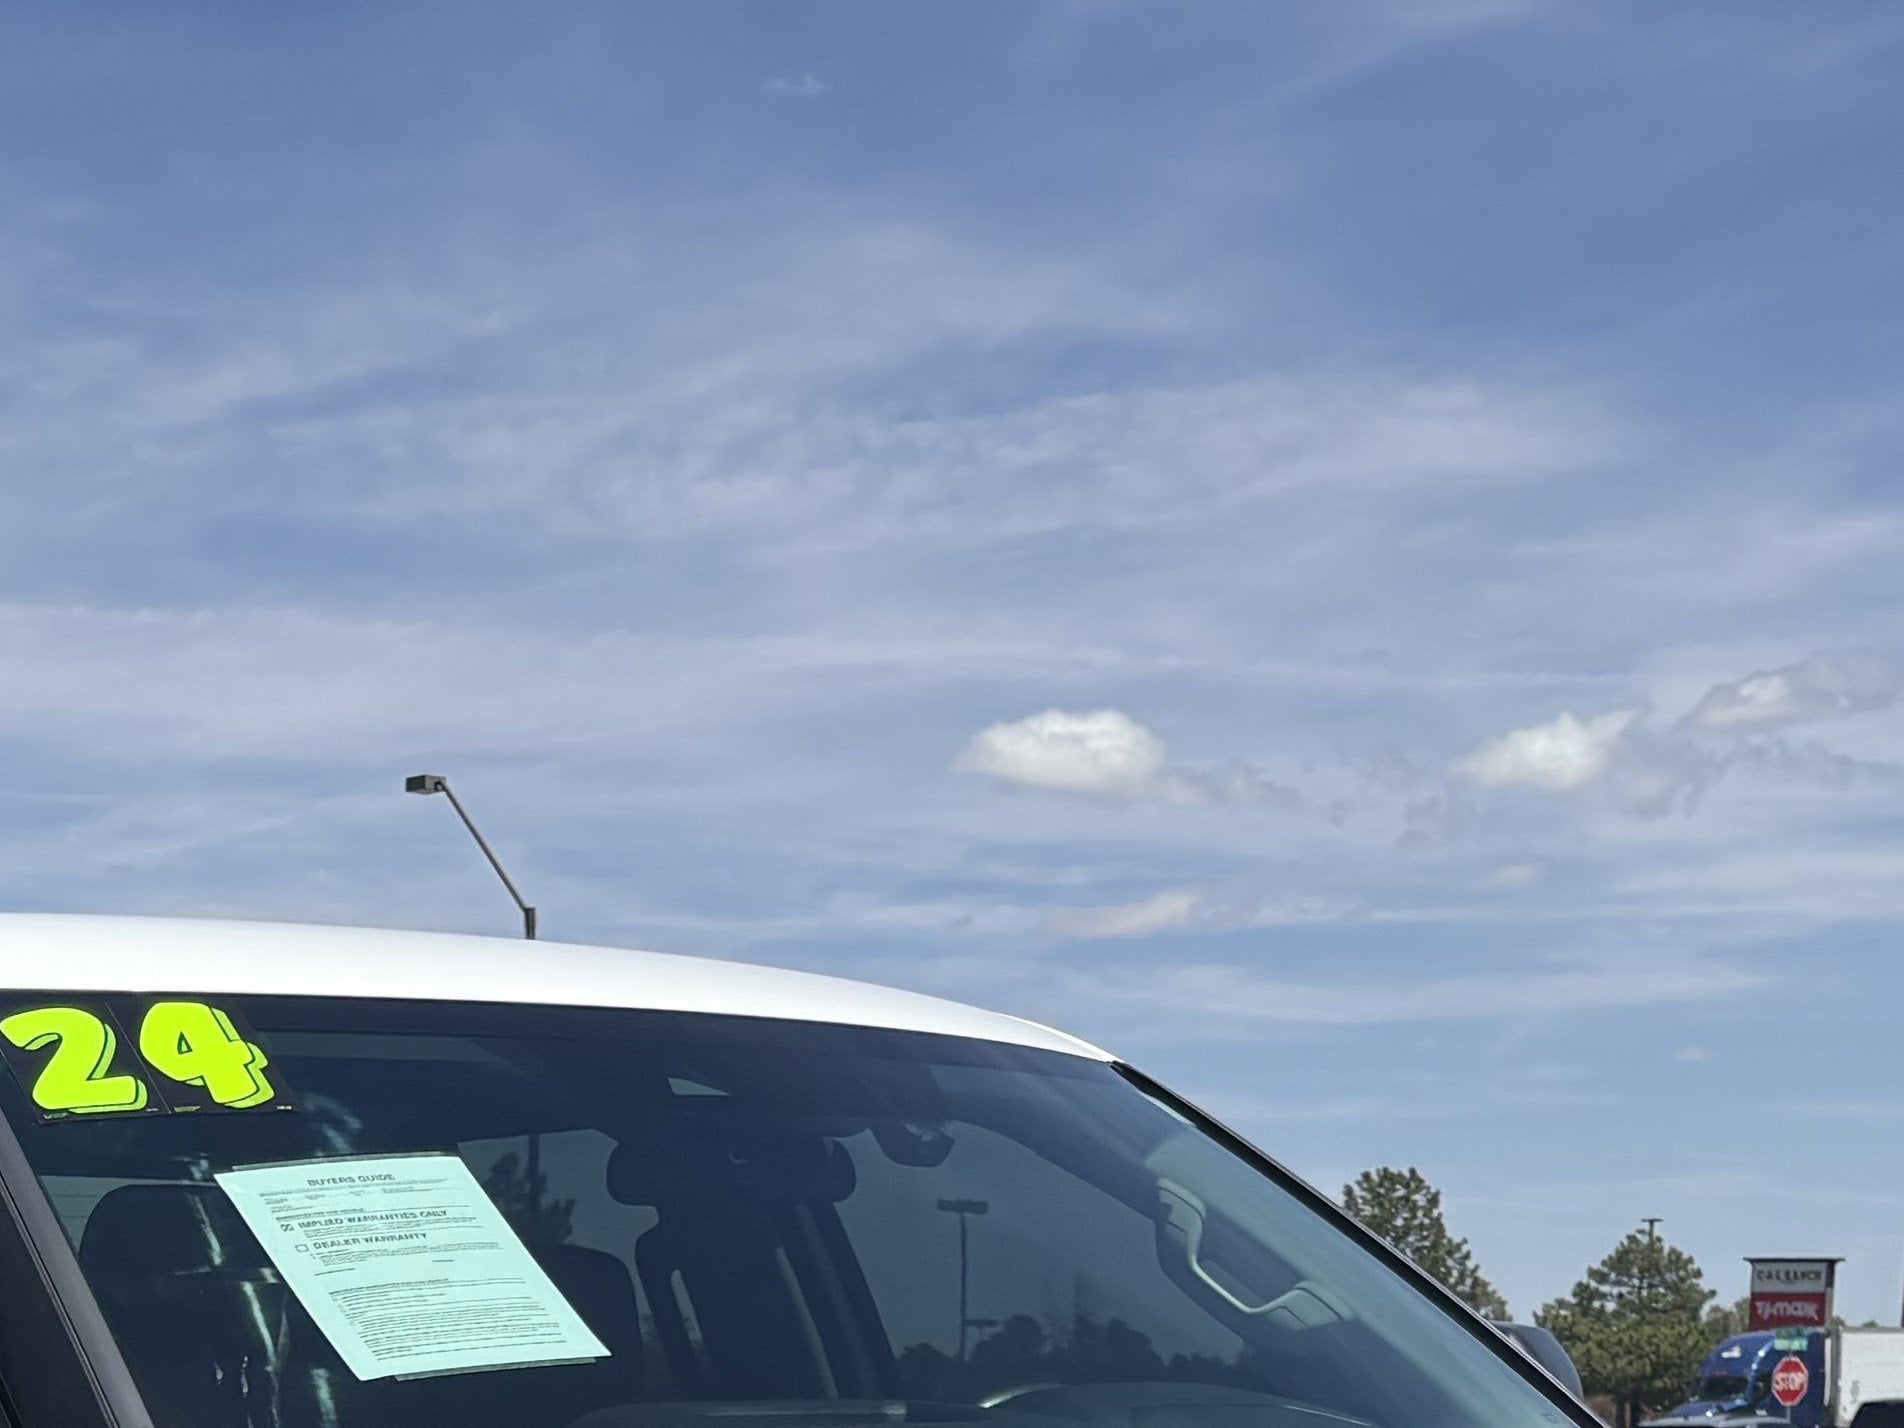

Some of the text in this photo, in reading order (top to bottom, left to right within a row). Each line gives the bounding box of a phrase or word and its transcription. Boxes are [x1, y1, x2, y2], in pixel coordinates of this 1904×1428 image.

[307, 1173, 396, 1187] BUYERS GUIDE
[313, 1232, 428, 1250] DEALER WARRANTY
[1774, 1371, 1806, 1391] STOP
